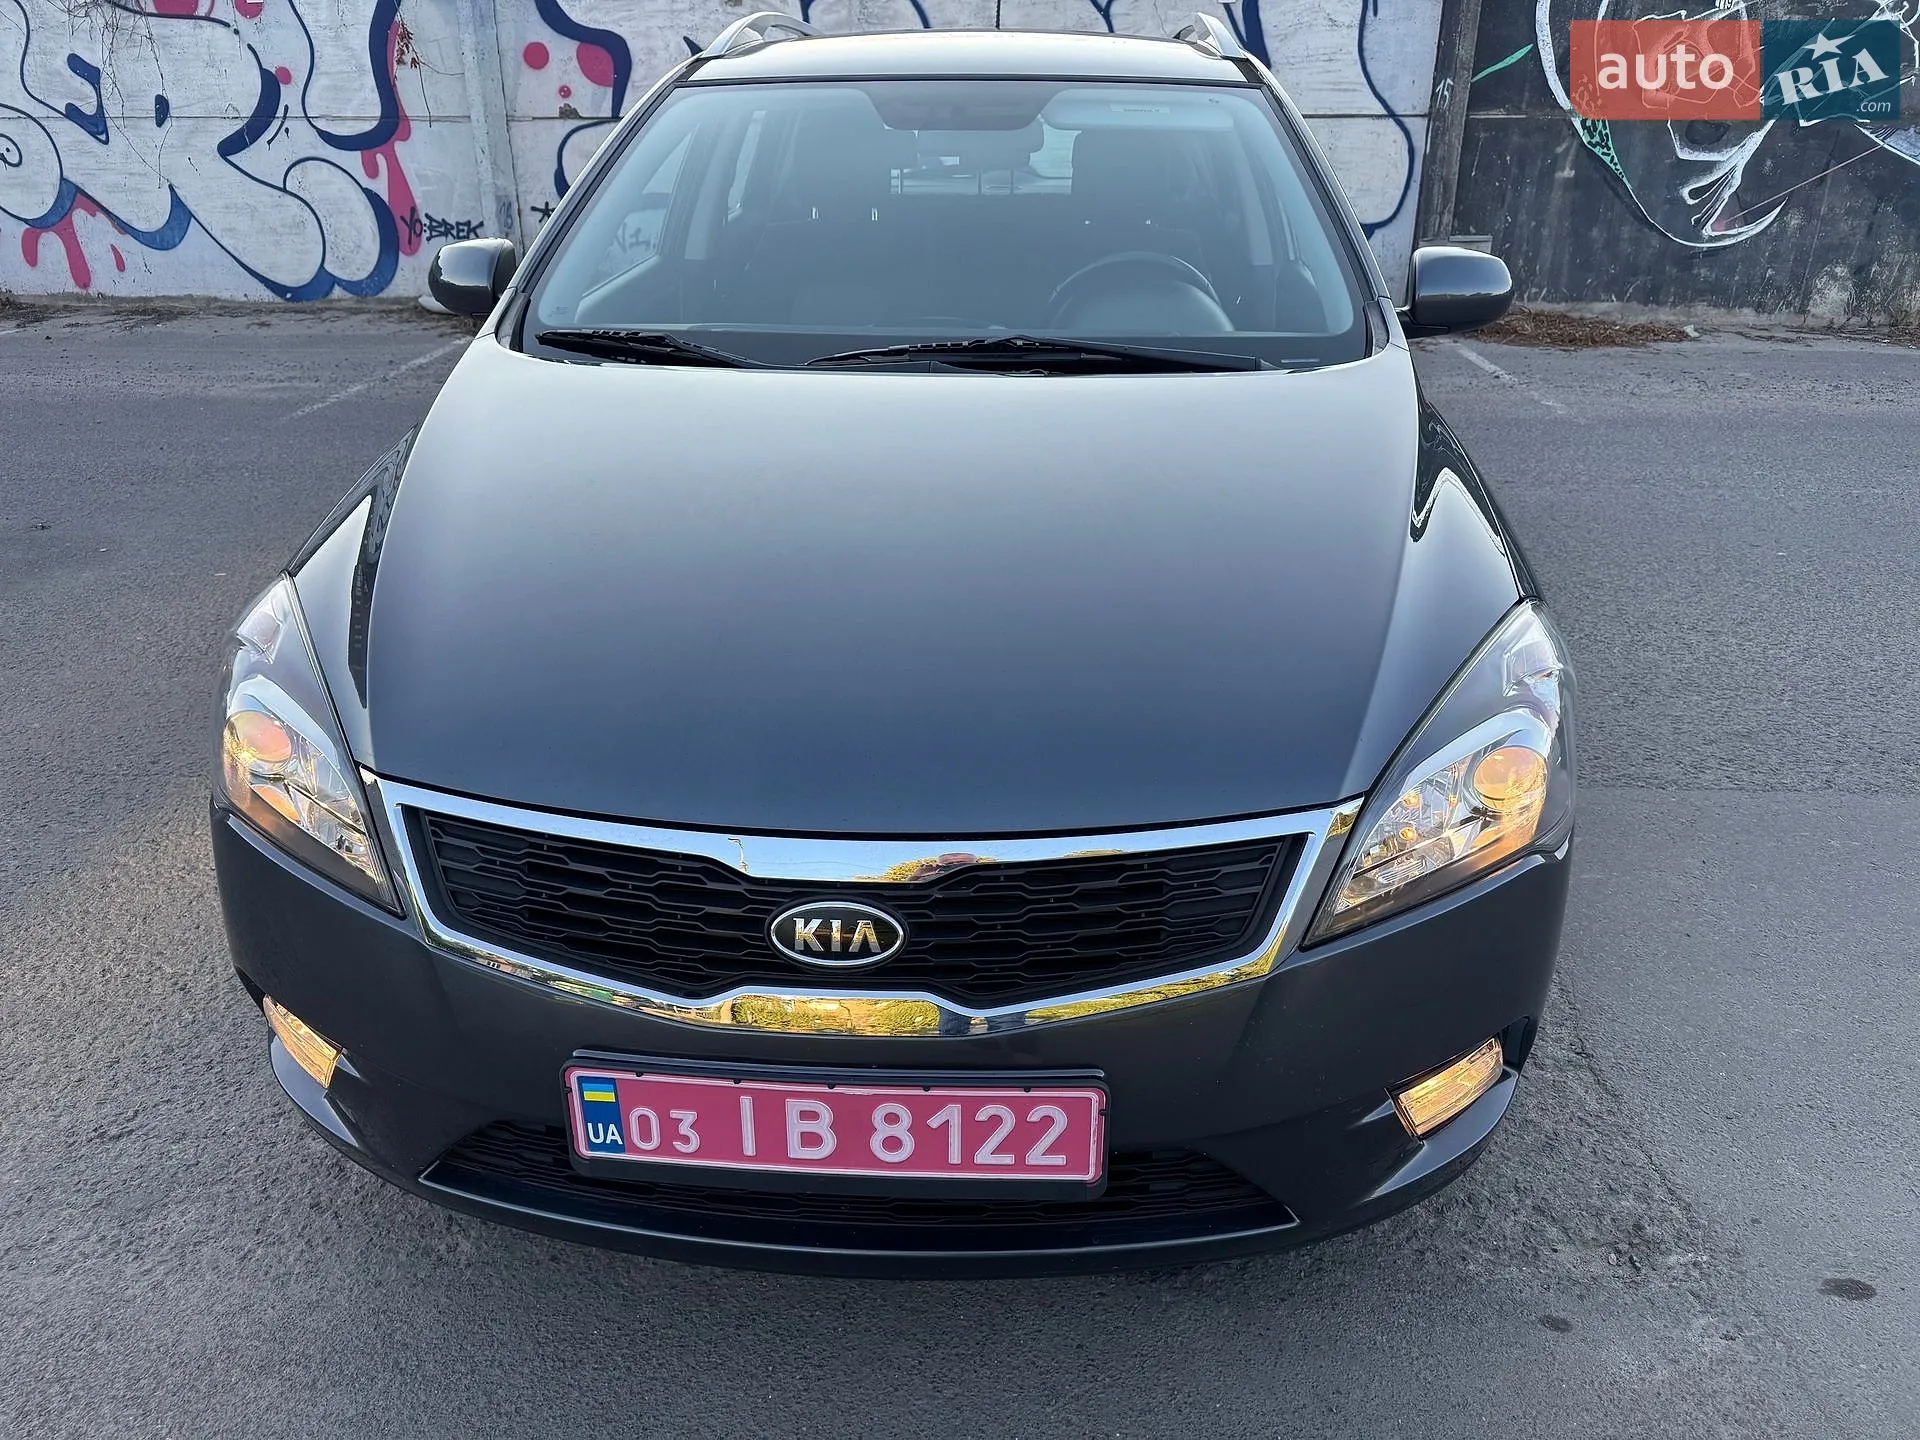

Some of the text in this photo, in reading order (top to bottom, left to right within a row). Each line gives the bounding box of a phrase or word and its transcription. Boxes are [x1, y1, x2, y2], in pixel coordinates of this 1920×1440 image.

[793, 917, 882, 953] KIA
[587, 1122, 623, 1145] UA
[629, 1095, 1068, 1166] 03 IB 8122
